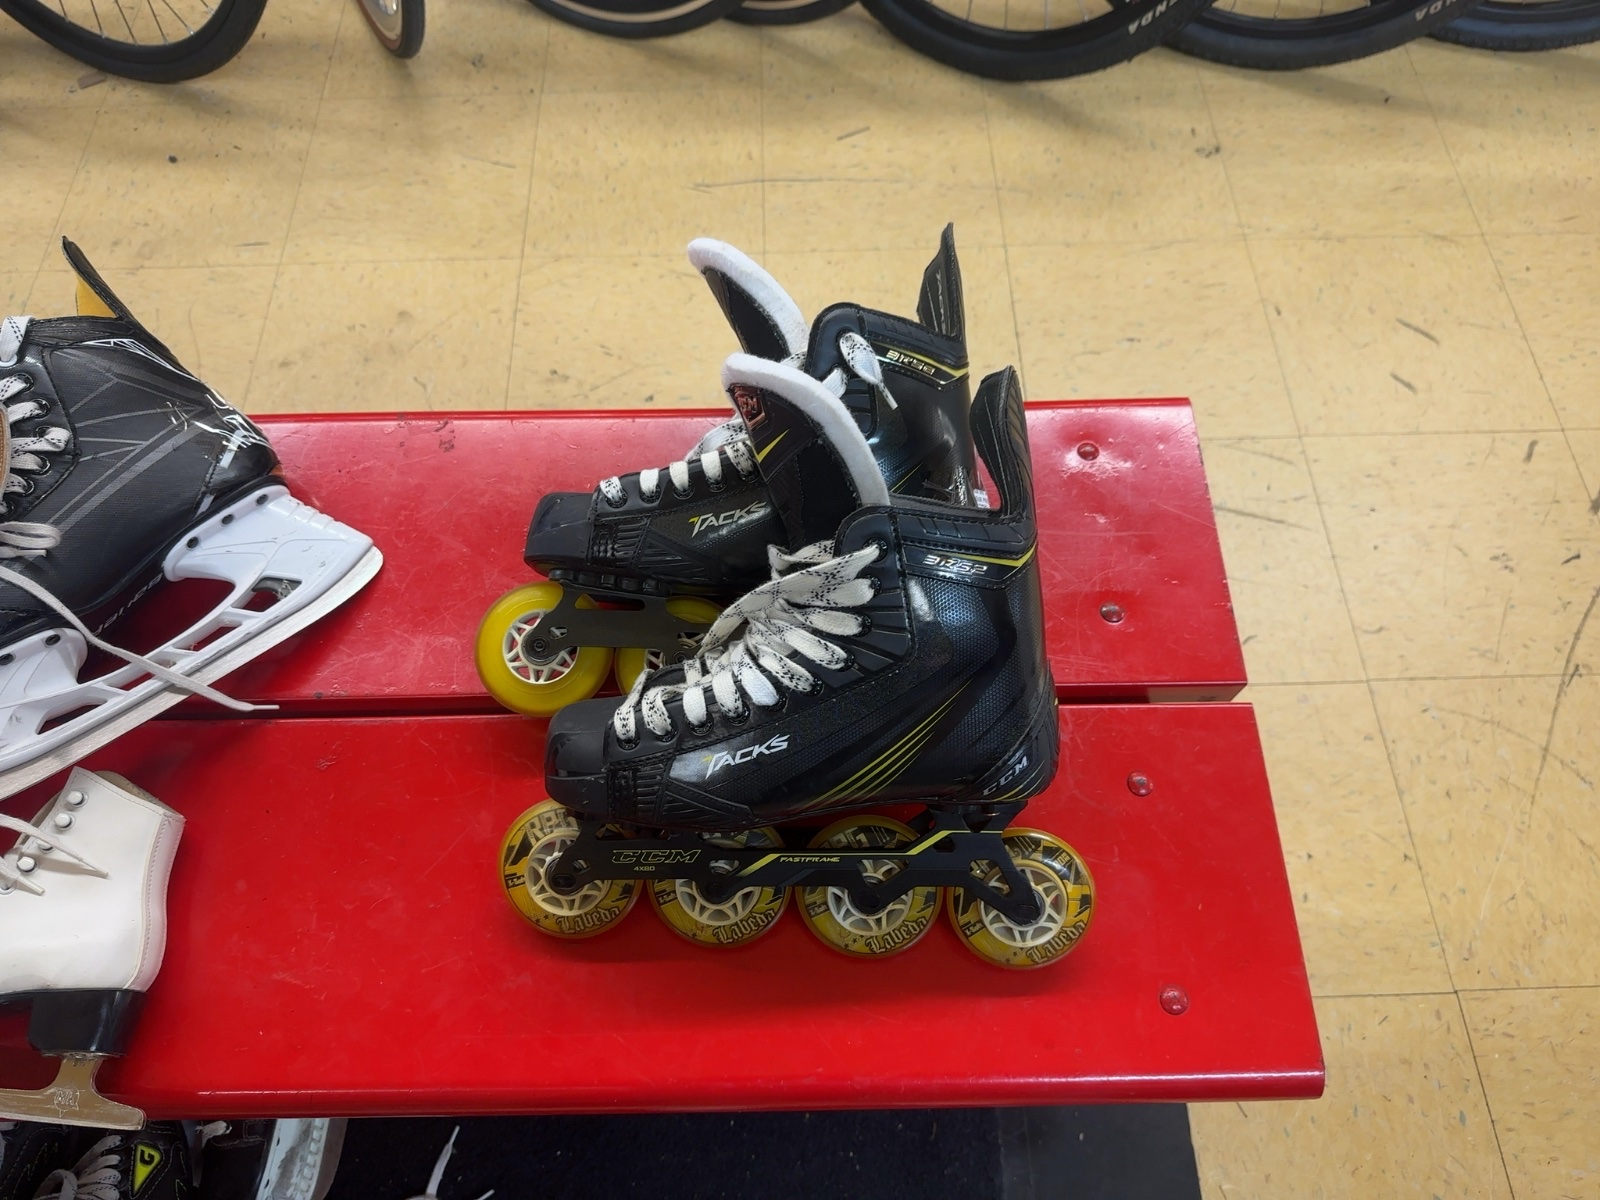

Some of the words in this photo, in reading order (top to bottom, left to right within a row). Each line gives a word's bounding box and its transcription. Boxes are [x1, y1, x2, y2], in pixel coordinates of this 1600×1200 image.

[688, 500, 767, 538] TACKS
[702, 733, 790, 780] TACKS
[982, 755, 1029, 796] CCM
[611, 849, 702, 863] CCM
[556, 905, 620, 934] Labeda
[713, 908, 776, 945] Labeda
[865, 916, 928, 954] Labeda
[1026, 920, 1087, 964] Labeda
